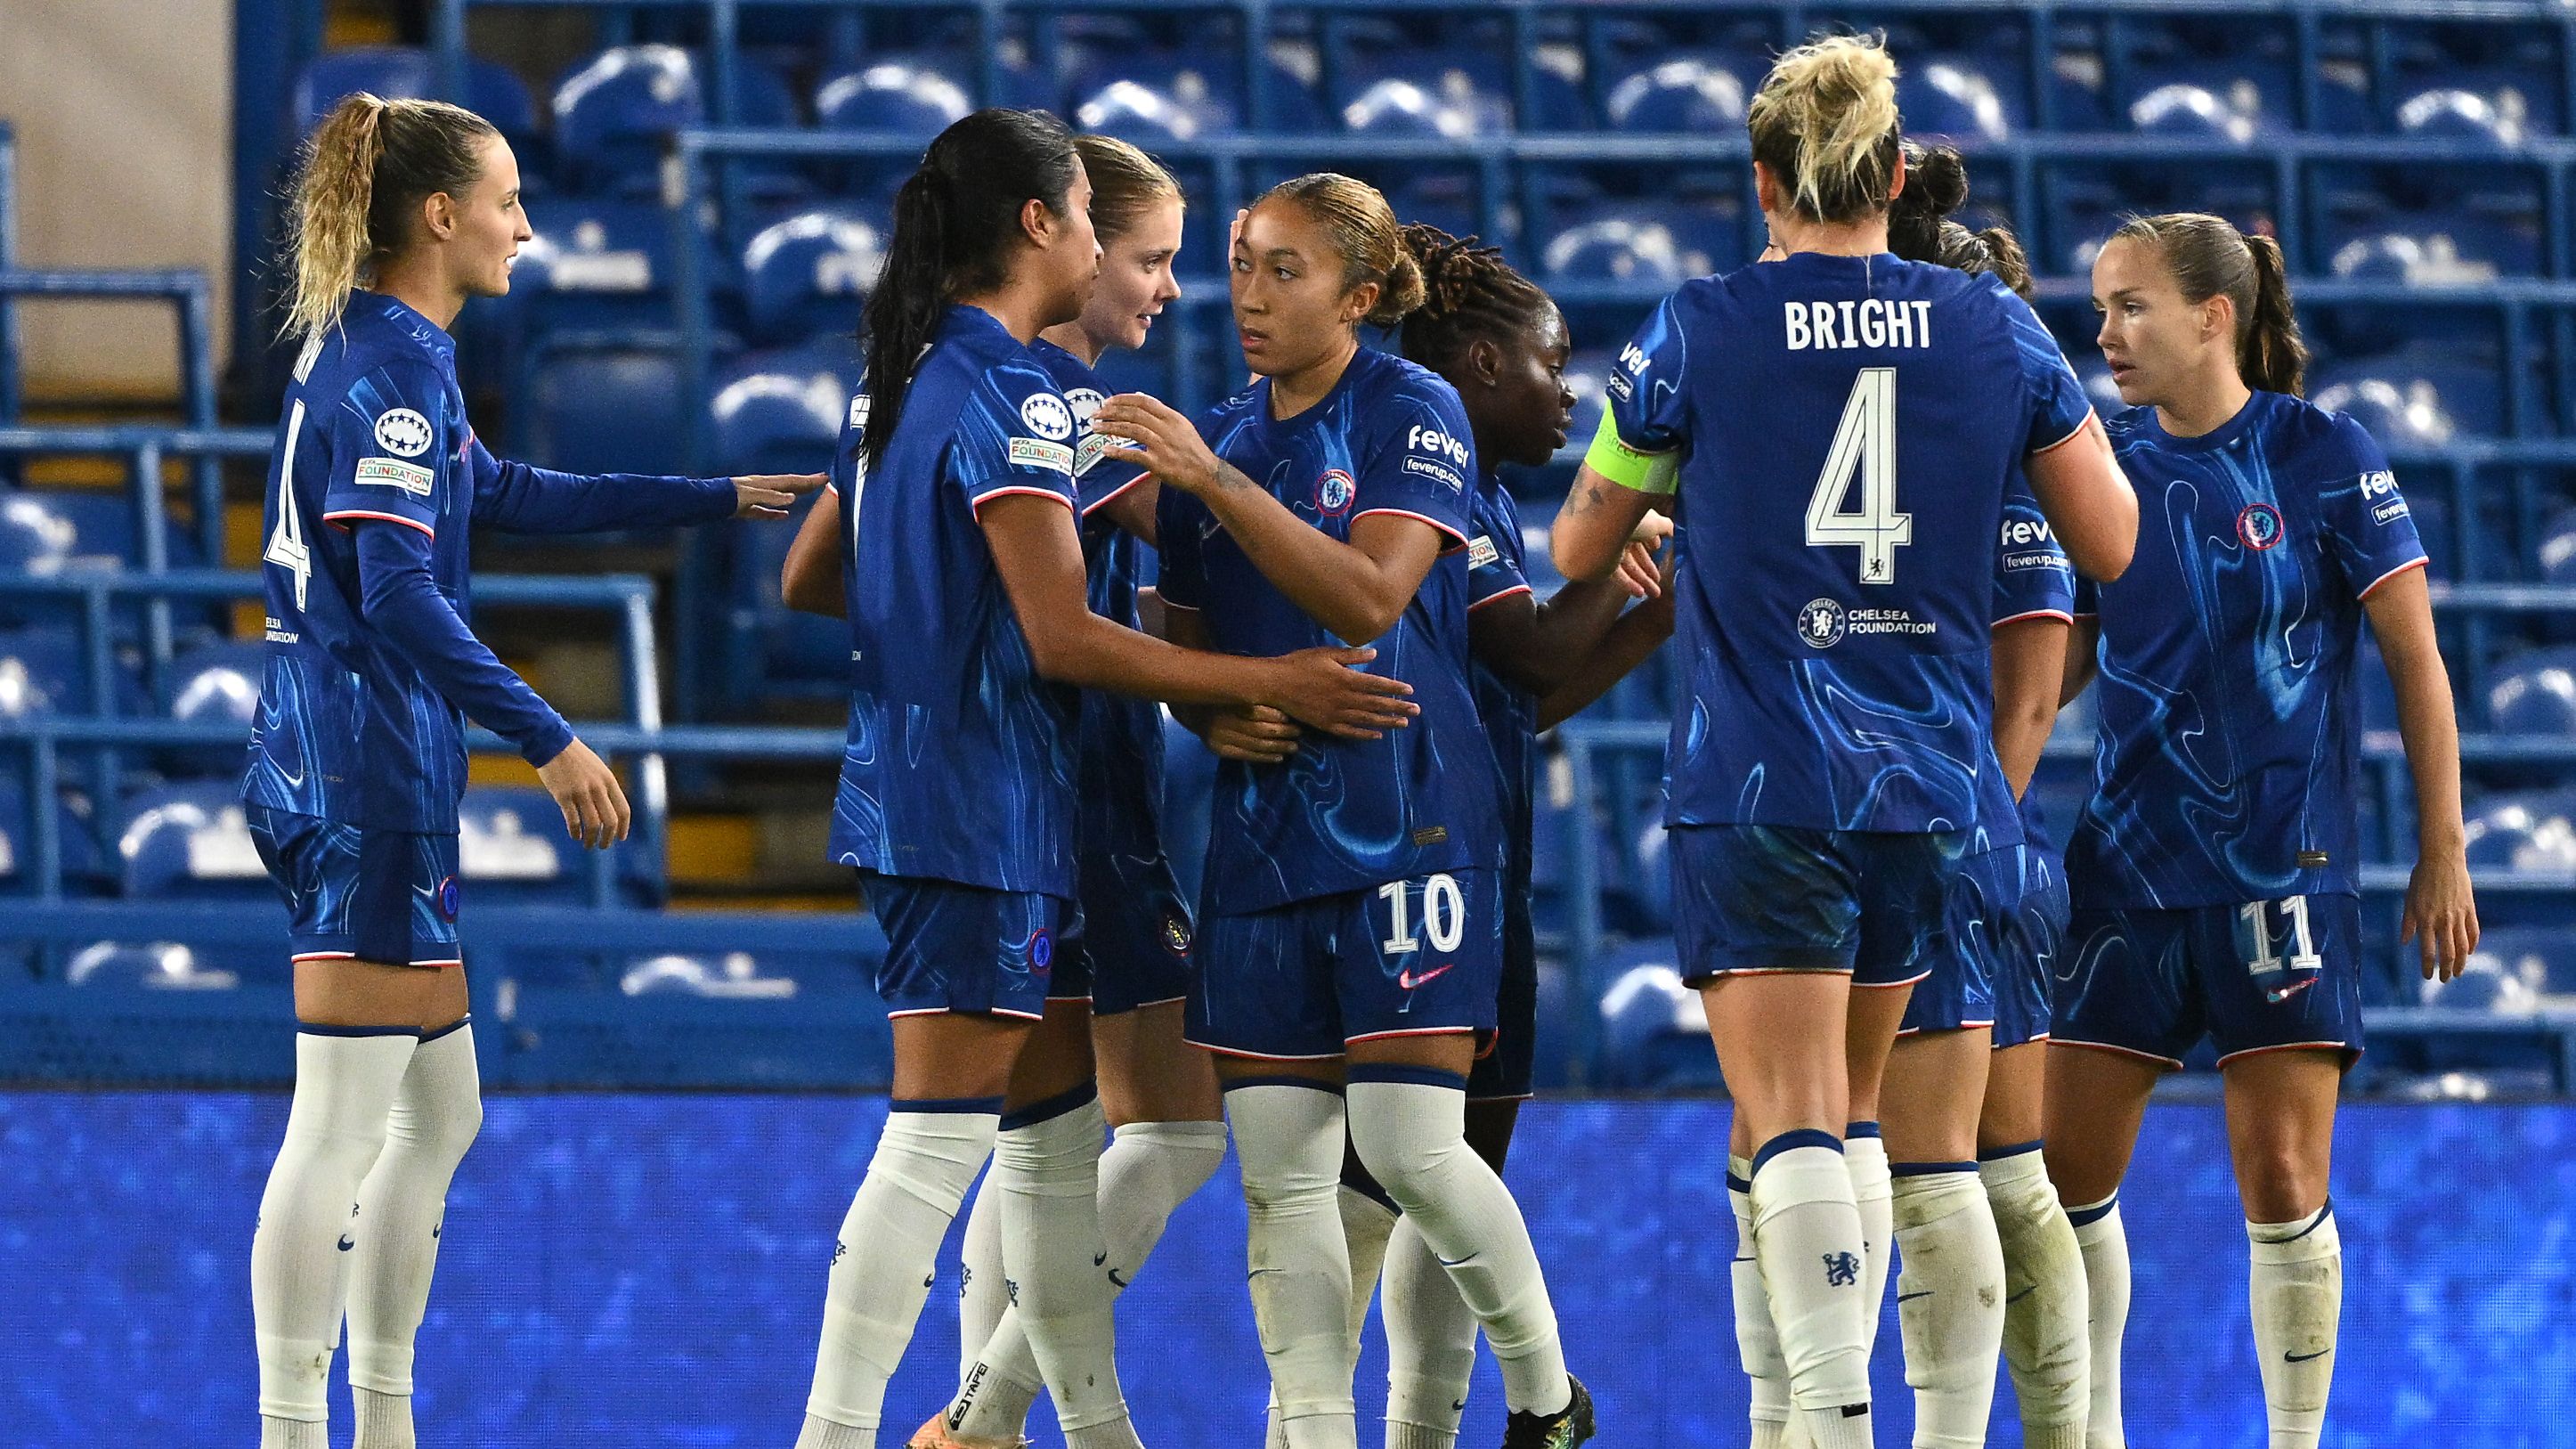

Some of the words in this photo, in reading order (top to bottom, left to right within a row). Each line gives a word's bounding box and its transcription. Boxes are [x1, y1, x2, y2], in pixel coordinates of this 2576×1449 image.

[1784, 298, 1931, 350] BRIGHT
[1408, 424, 1469, 469] fever
[358, 466, 431, 487] FOUNDATION
[1407, 458, 1462, 490] feverup.com
[1805, 367, 1912, 584] 4
[264, 398, 312, 613] 4
[1848, 609, 1910, 621] CHELSEA
[1849, 622, 1936, 634] FOUNDATION
[1378, 873, 1465, 955] 10
[2240, 894, 2322, 975] 11
